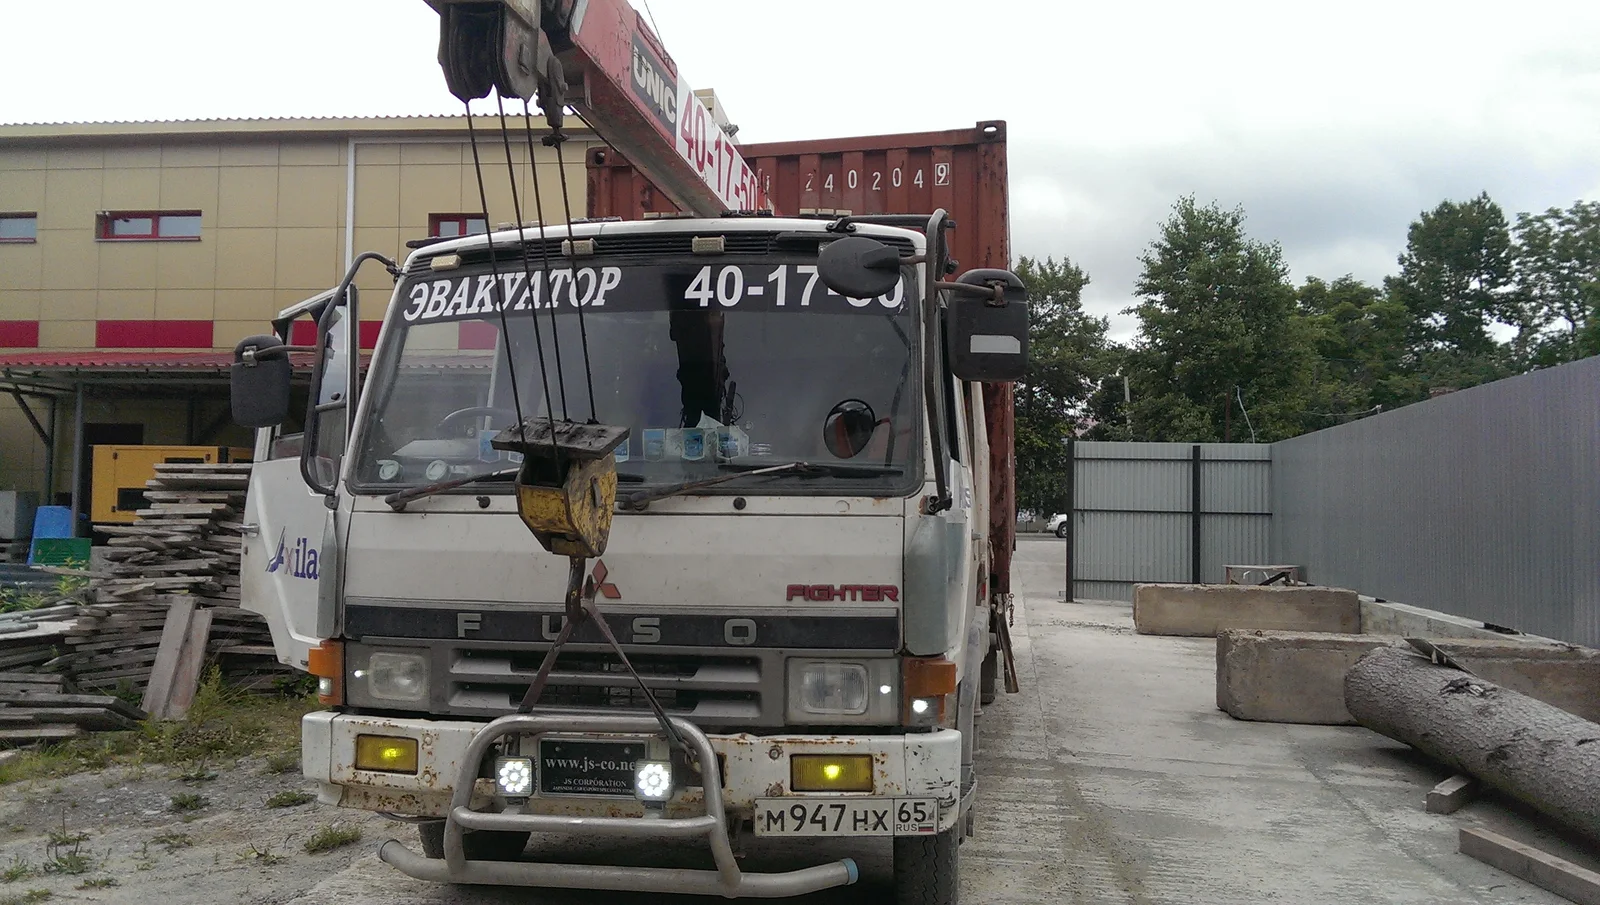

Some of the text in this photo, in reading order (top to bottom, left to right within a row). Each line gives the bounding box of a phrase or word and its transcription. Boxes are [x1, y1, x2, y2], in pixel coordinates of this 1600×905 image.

[633, 45, 676, 124] UNIC
[680, 91, 757, 212] 40-17-50
[403, 266, 622, 321] ЭВАКУАТОР
[684, 264, 904, 309] 40-17-0
[265, 526, 320, 580] Axila
[786, 584, 899, 602] FIGHTER
[456, 612, 757, 645] FUSO
[545, 756, 636, 773] www.js-co.ne
[573, 778, 627, 787] CORPORATION
[896, 823, 917, 832] RUS
[897, 802, 926, 822] 65
